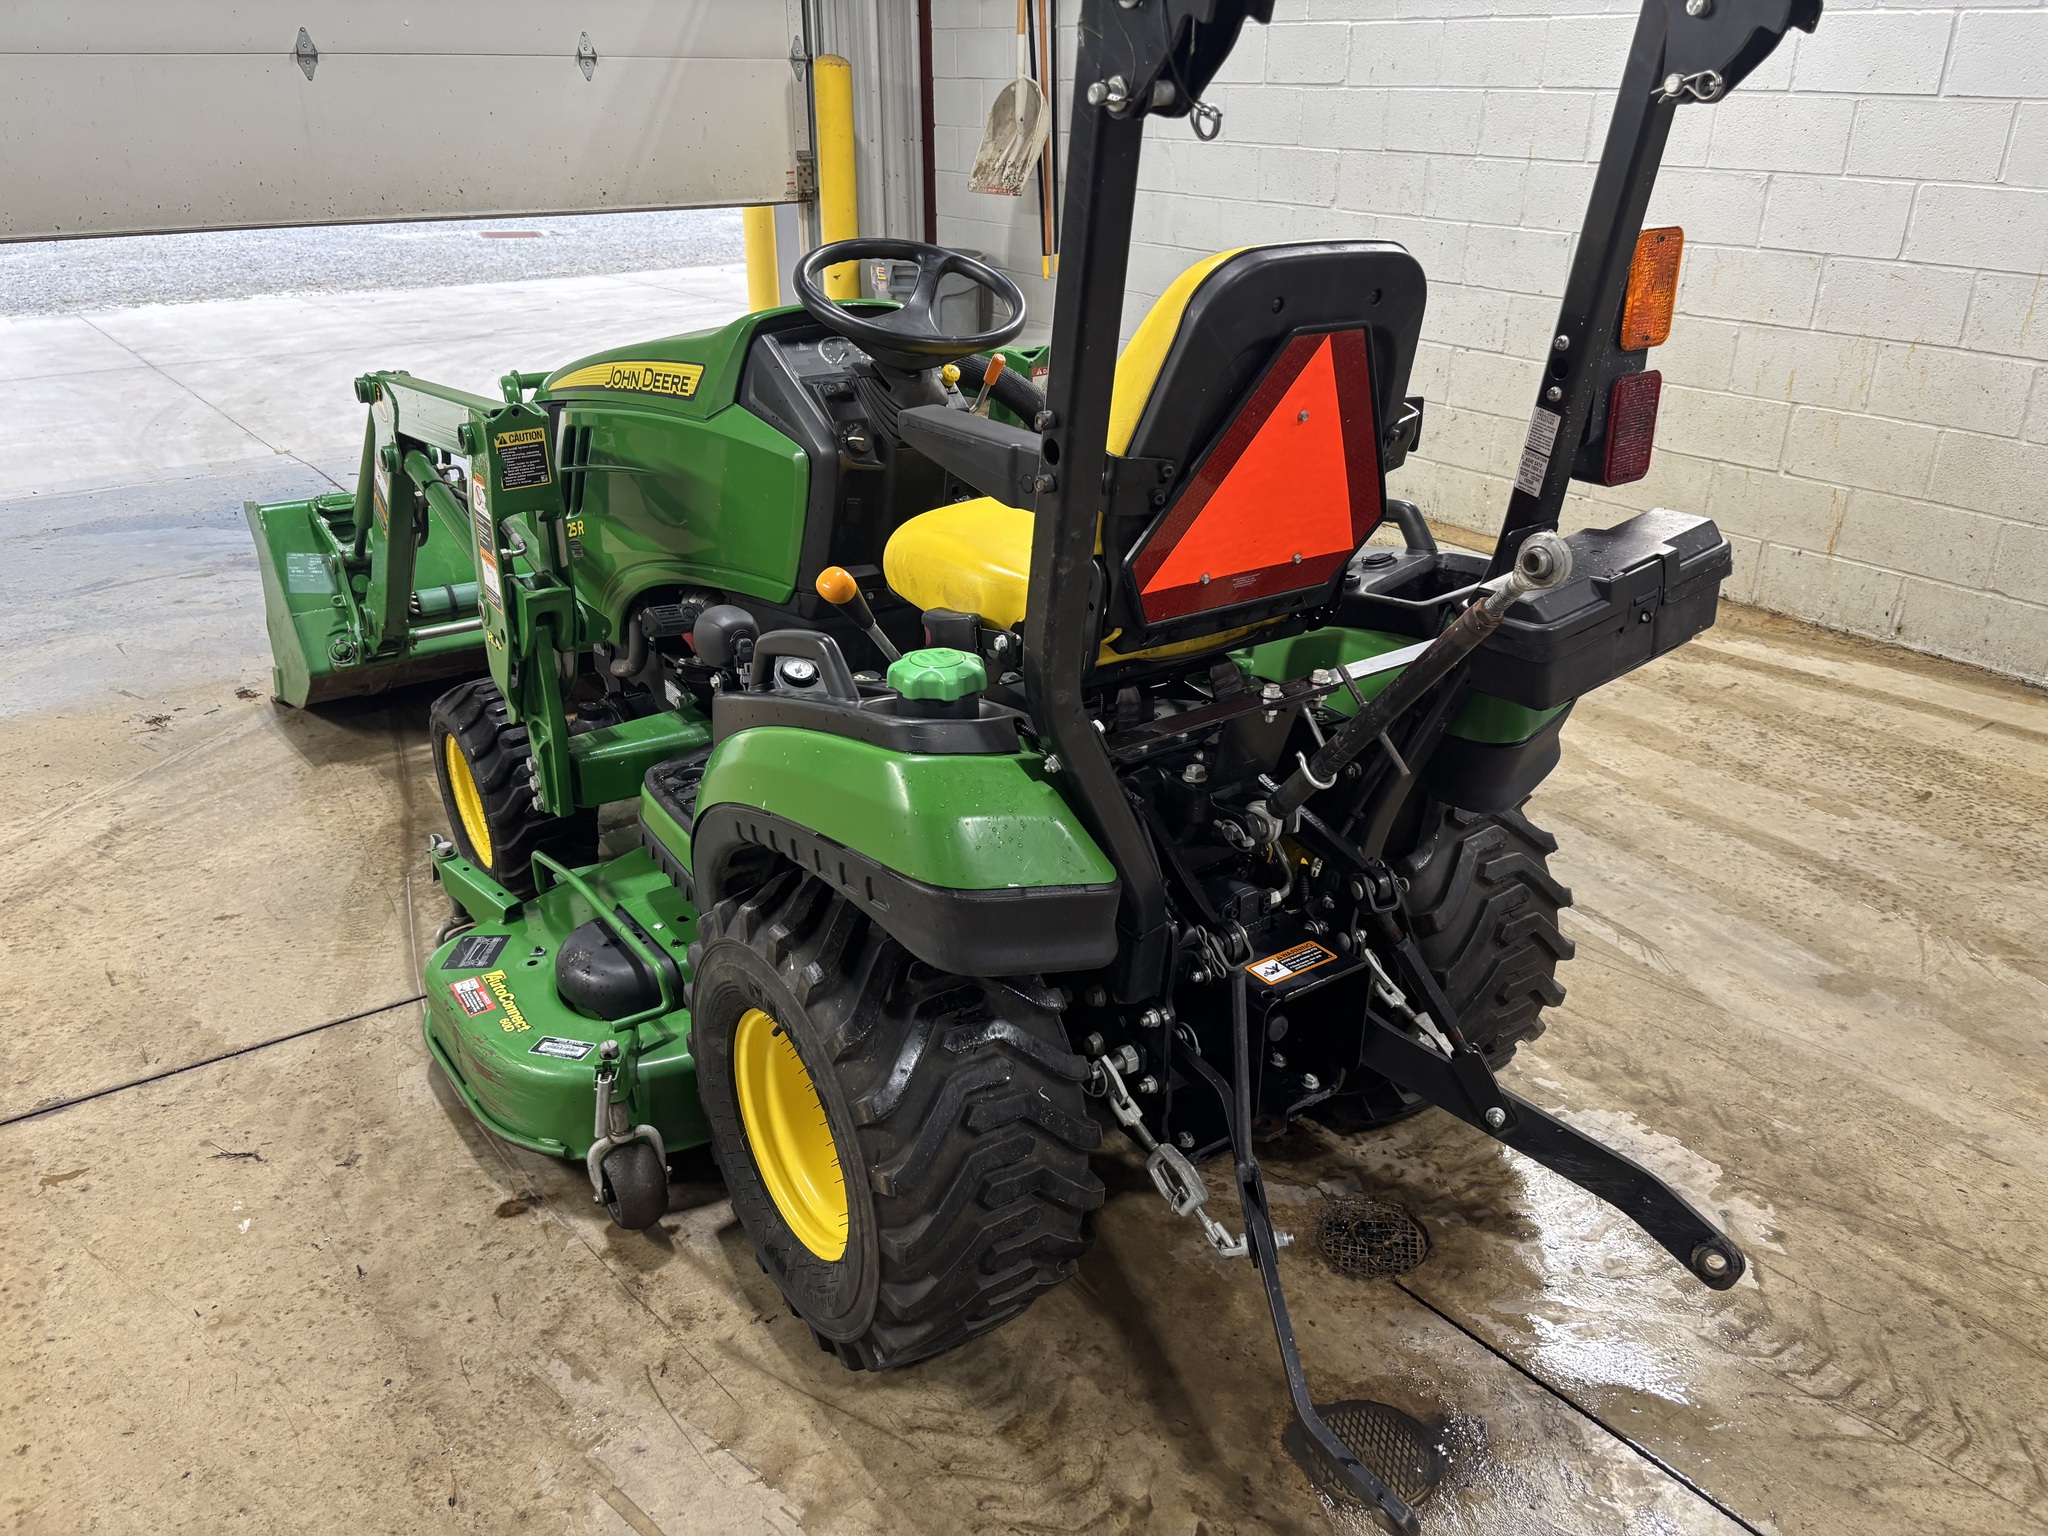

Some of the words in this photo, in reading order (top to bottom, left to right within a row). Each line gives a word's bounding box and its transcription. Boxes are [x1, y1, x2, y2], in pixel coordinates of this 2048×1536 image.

[605, 366, 641, 387] JOHN
[643, 368, 691, 393] DEERE
[508, 430, 543, 443] CAUTION
[1282, 942, 1313, 958] WARNING
[483, 972, 532, 1033] AutoConnect
[499, 1018, 515, 1032] 60D
